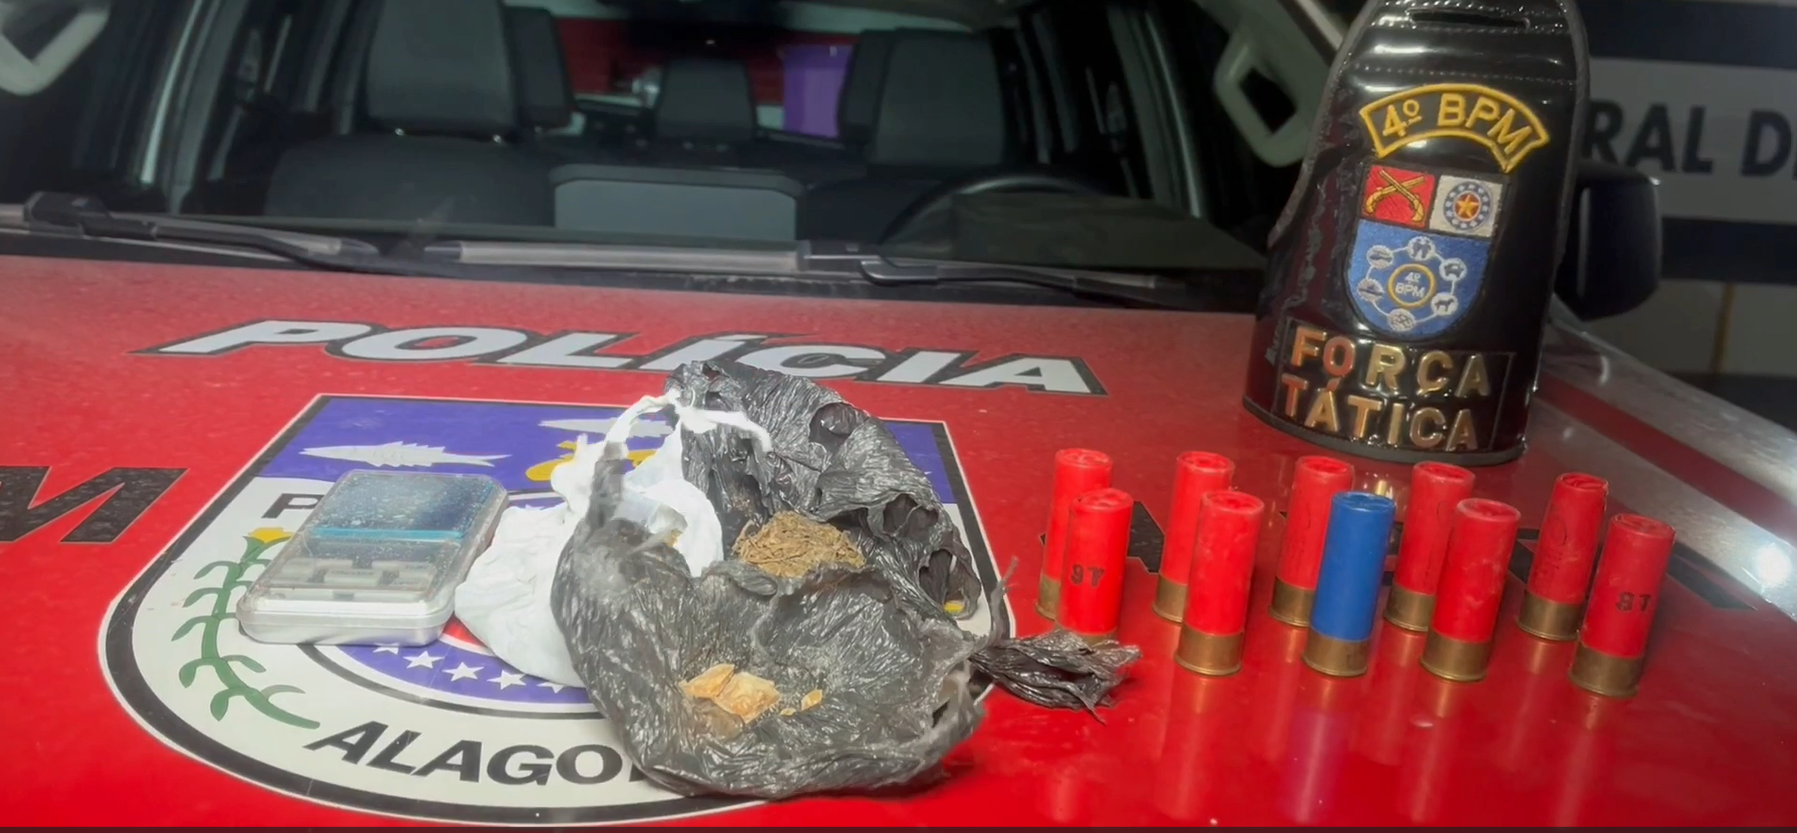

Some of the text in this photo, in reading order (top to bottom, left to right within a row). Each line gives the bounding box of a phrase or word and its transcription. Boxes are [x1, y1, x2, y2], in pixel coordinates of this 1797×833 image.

[1437, 92, 1533, 155] BPM
[1741, 108, 1797, 180] D
[1395, 282, 1426, 298] BPM
[140, 318, 1098, 394] POLÍCIA
[1291, 325, 1491, 398] FORÇA
[1281, 374, 1479, 451] TÁTICA
[302, 720, 648, 786] ALAGO
